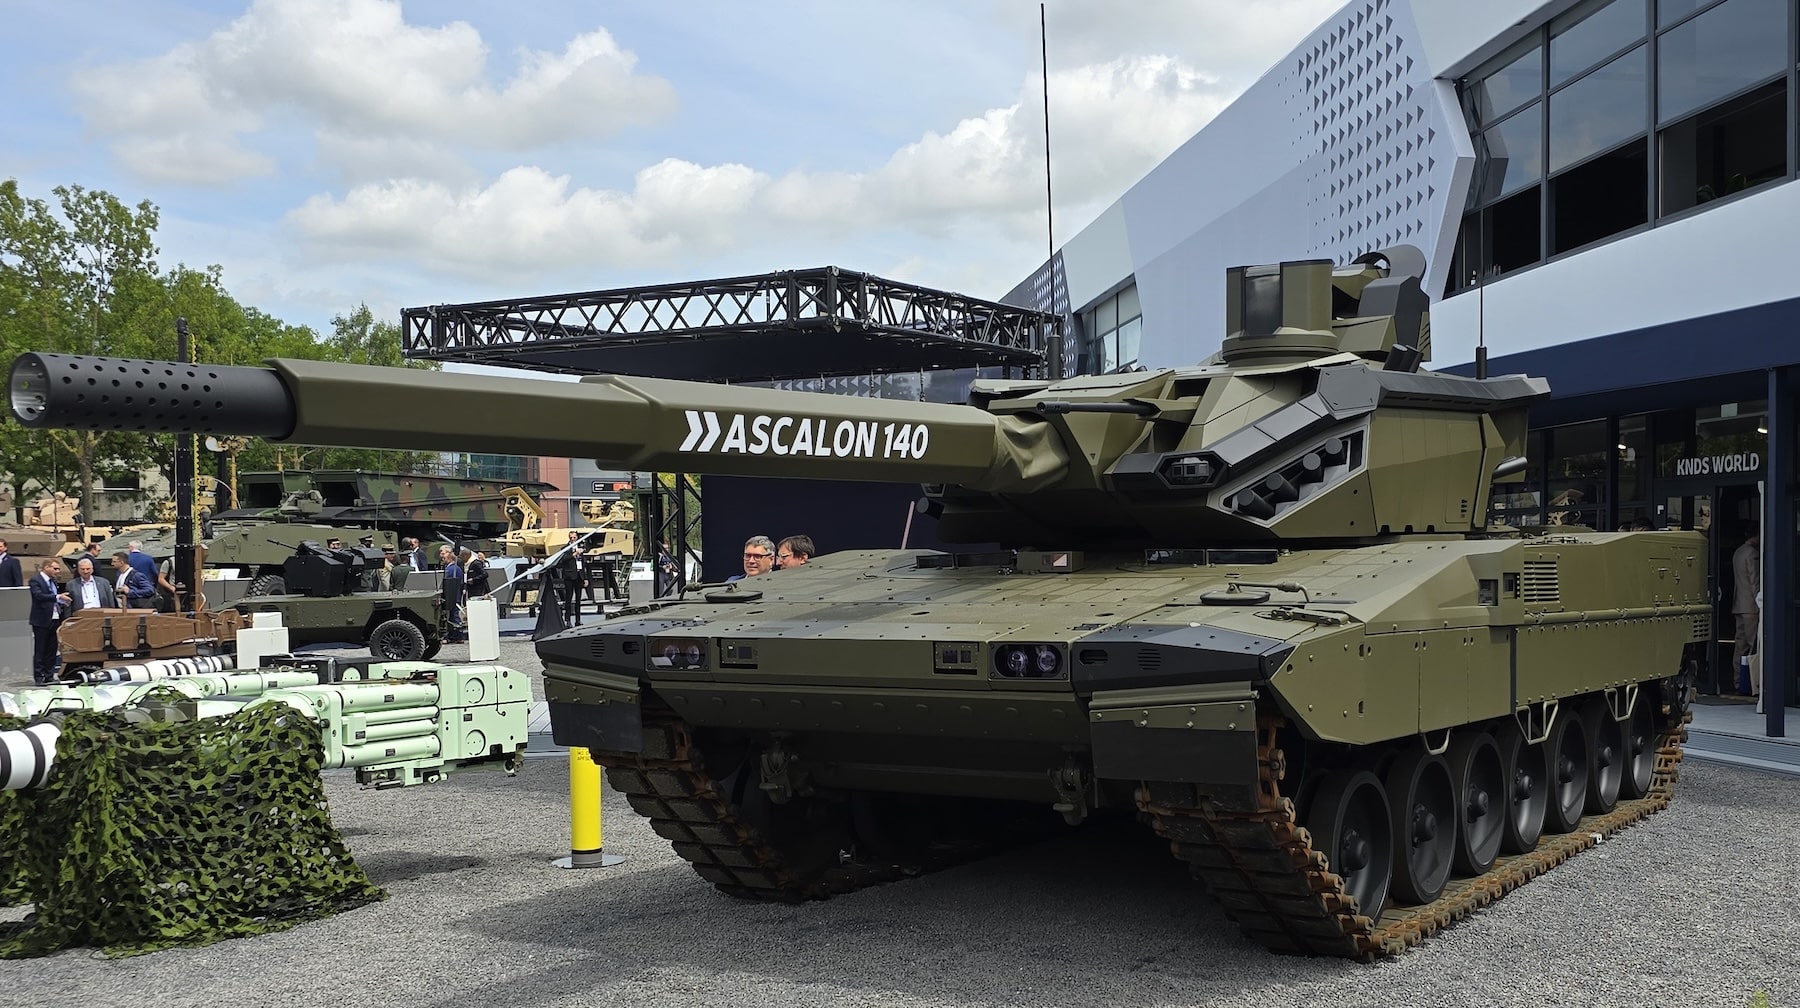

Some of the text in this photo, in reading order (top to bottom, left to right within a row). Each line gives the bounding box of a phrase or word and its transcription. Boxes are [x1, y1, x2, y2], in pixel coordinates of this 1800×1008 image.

[721, 414, 929, 459] ASCALON 140
[1677, 453, 1760, 475] KNDS WORLD
